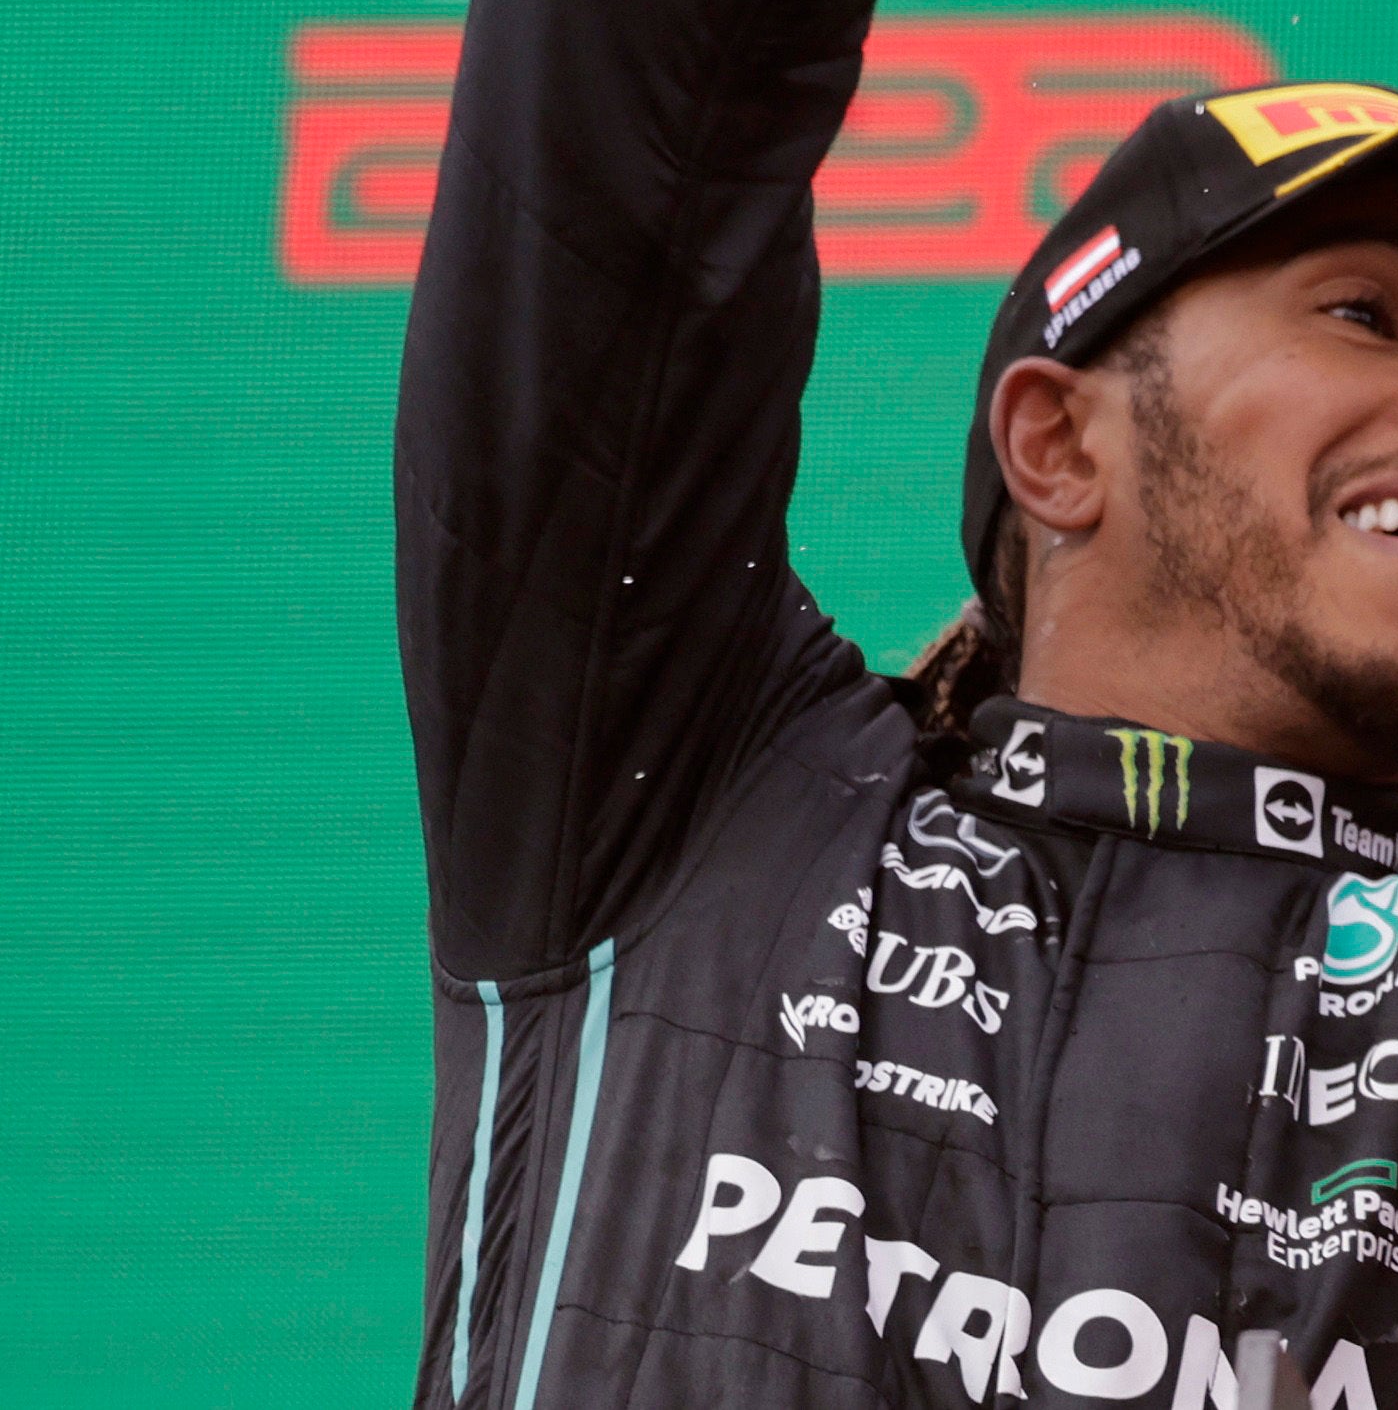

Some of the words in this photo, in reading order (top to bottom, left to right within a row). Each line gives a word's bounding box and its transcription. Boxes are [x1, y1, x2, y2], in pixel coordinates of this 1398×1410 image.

[1044, 247, 1141, 350] SPIELBERG
[867, 930, 1010, 1035] UBS
[1216, 1182, 1348, 1241] Hewlett
